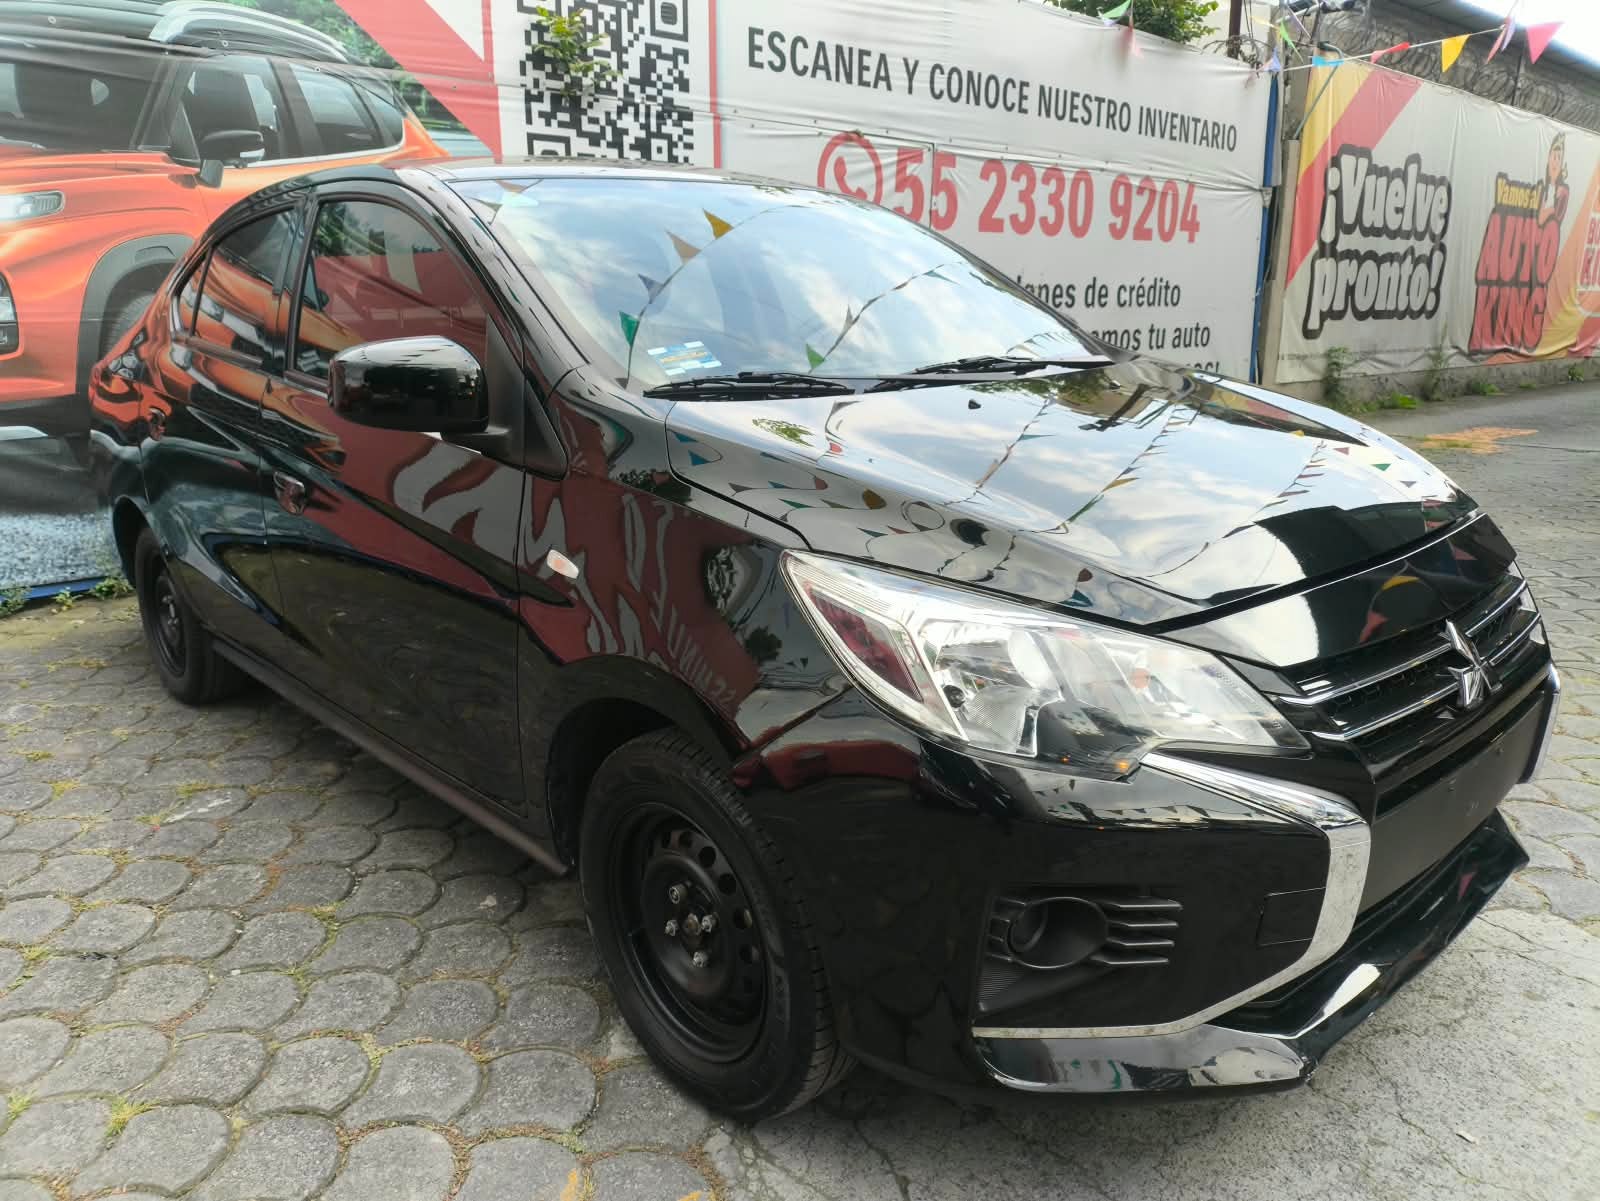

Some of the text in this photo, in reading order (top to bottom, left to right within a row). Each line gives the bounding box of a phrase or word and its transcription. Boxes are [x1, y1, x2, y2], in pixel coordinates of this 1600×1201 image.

[748, 26, 1237, 152] ESCANEA Y CONOCE NUESTRO INVENTARIO
[893, 146, 1200, 243] 55 2330 9204
[1319, 150, 1450, 243] ¡Vuelve
[1476, 213, 1561, 282] AUTO
[1084, 277, 1108, 308] de
[1117, 277, 1181, 307] crédito
[1305, 247, 1446, 335] pronto!
[1469, 286, 1548, 352] KING
[1149, 323, 1166, 349] tu
[1172, 322, 1210, 348] auto
